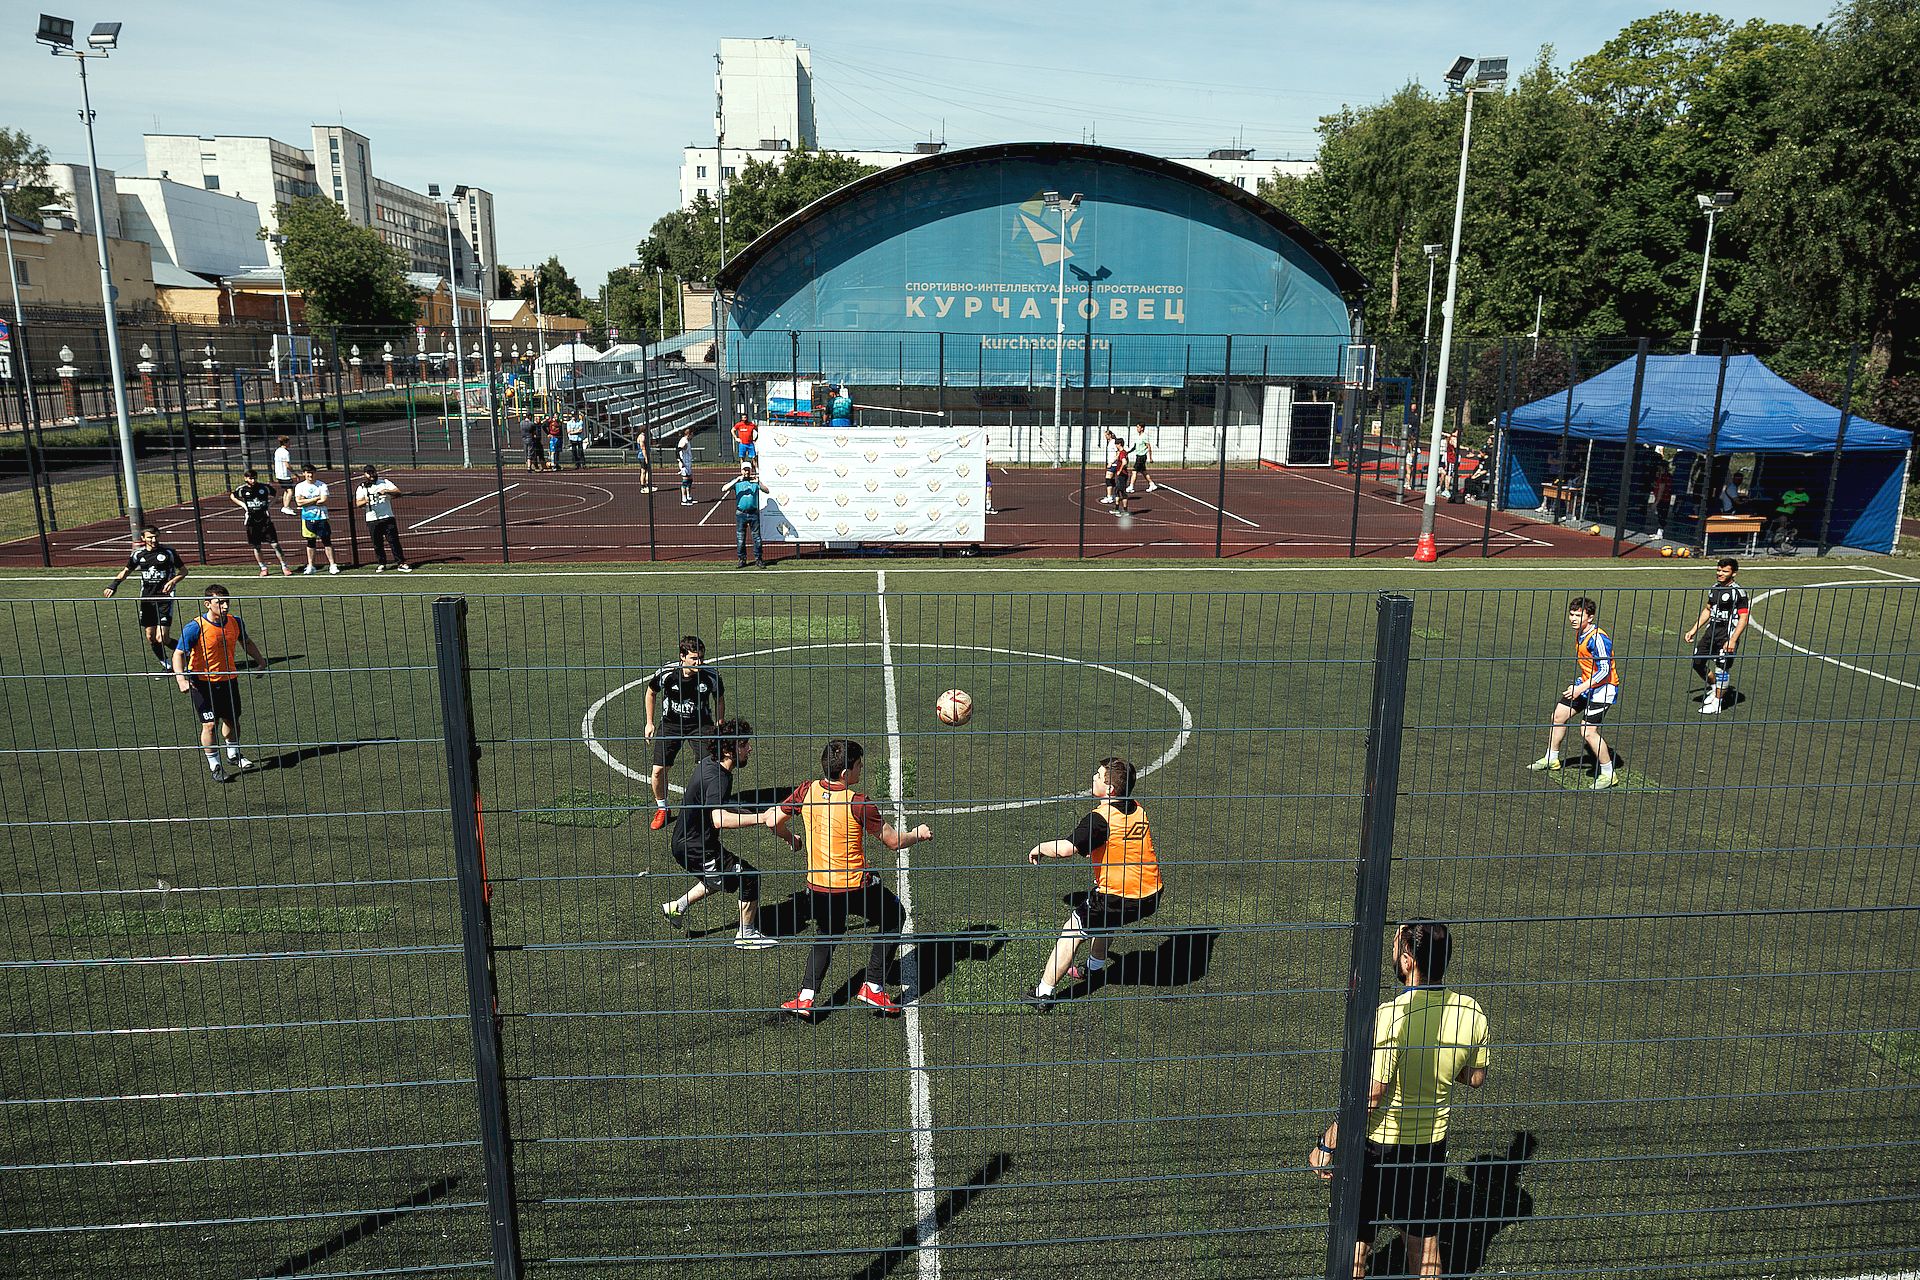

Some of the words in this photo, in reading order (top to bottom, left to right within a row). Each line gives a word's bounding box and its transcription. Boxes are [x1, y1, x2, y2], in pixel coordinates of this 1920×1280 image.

[1096, 284, 1184, 294] ПРОСТРАНСТВО
[905, 295, 1185, 324] КУРЧАТОВЕЦ
[982, 335, 1109, 350] kurchatoecru
[202, 711, 214, 721] 80
